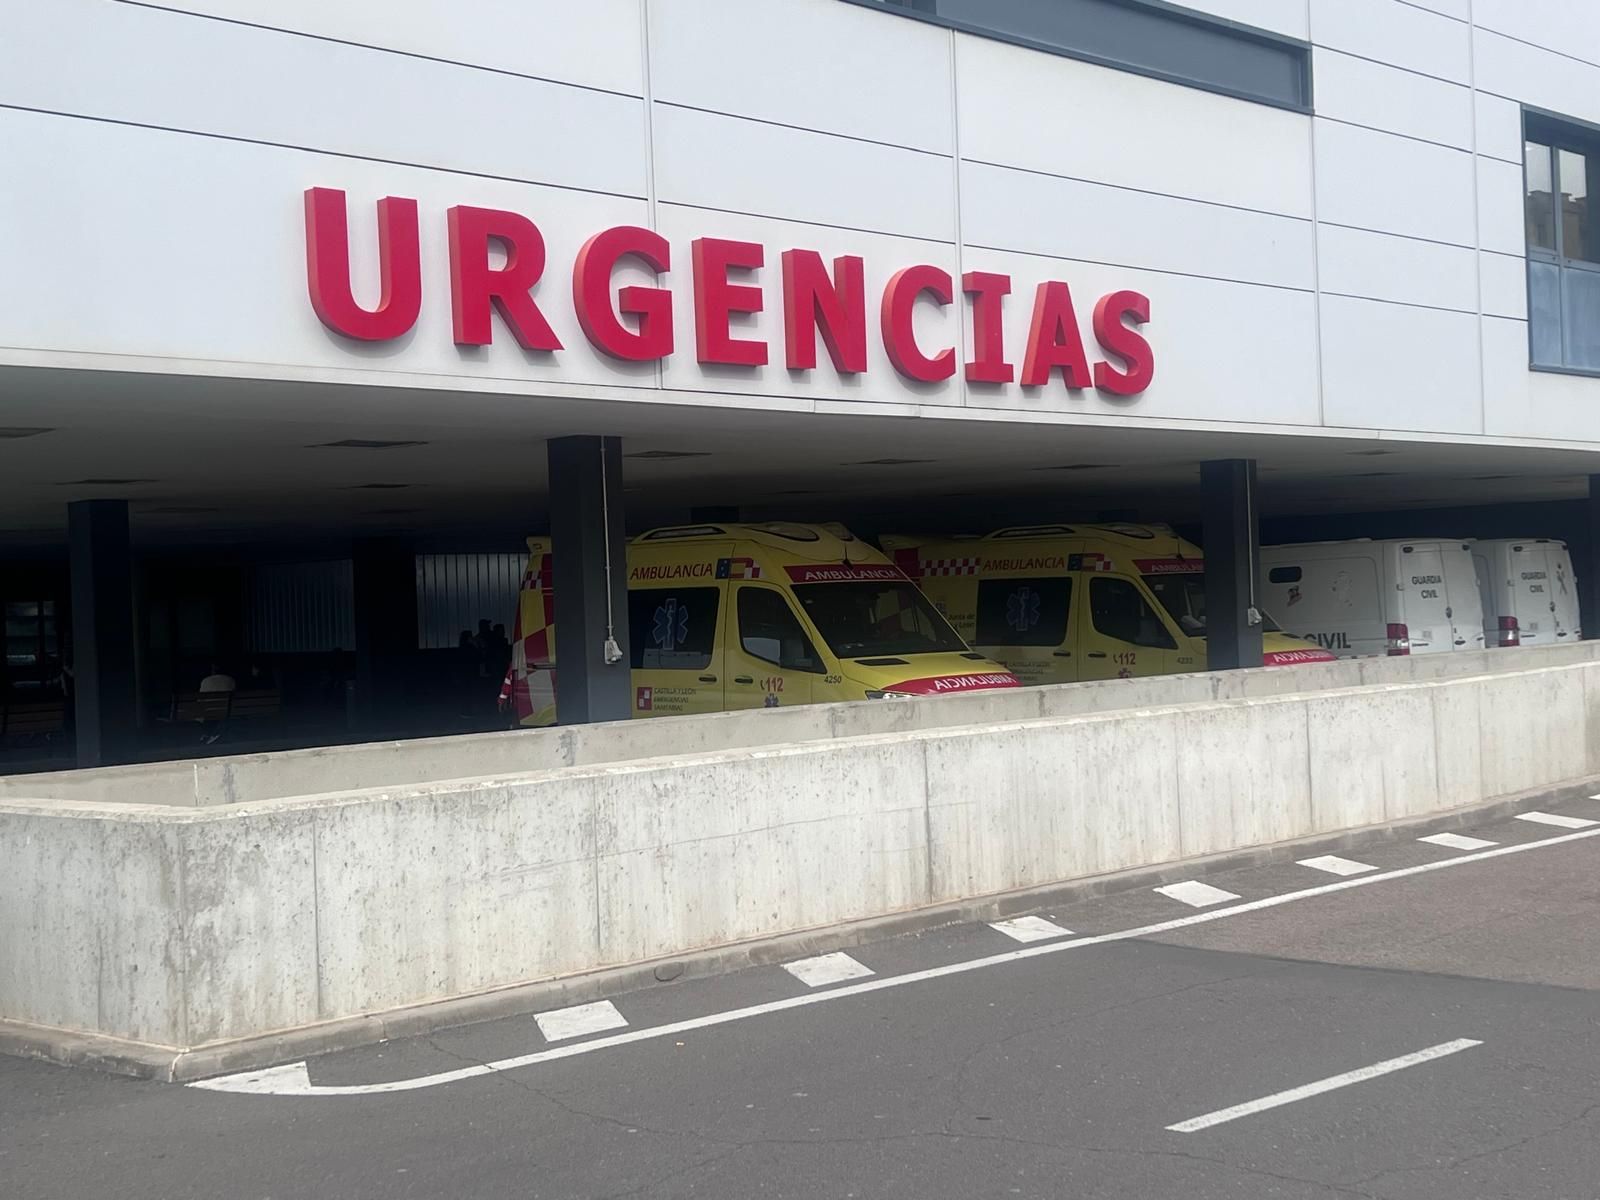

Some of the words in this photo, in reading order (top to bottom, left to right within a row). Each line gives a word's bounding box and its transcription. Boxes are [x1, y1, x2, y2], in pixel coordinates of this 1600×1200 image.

[303, 186, 1155, 396] URGENCIAS
[982, 557, 1066, 571] AMBULANCIA
[630, 563, 714, 580] AMBULANCIA
[805, 570, 898, 580] AMBULANCIA
[1411, 575, 1442, 585] GUARDIA
[1421, 589, 1439, 599] CIVIL
[1119, 653, 1136, 665] 112
[766, 677, 784, 692] 112
[824, 675, 842, 684] 4250
